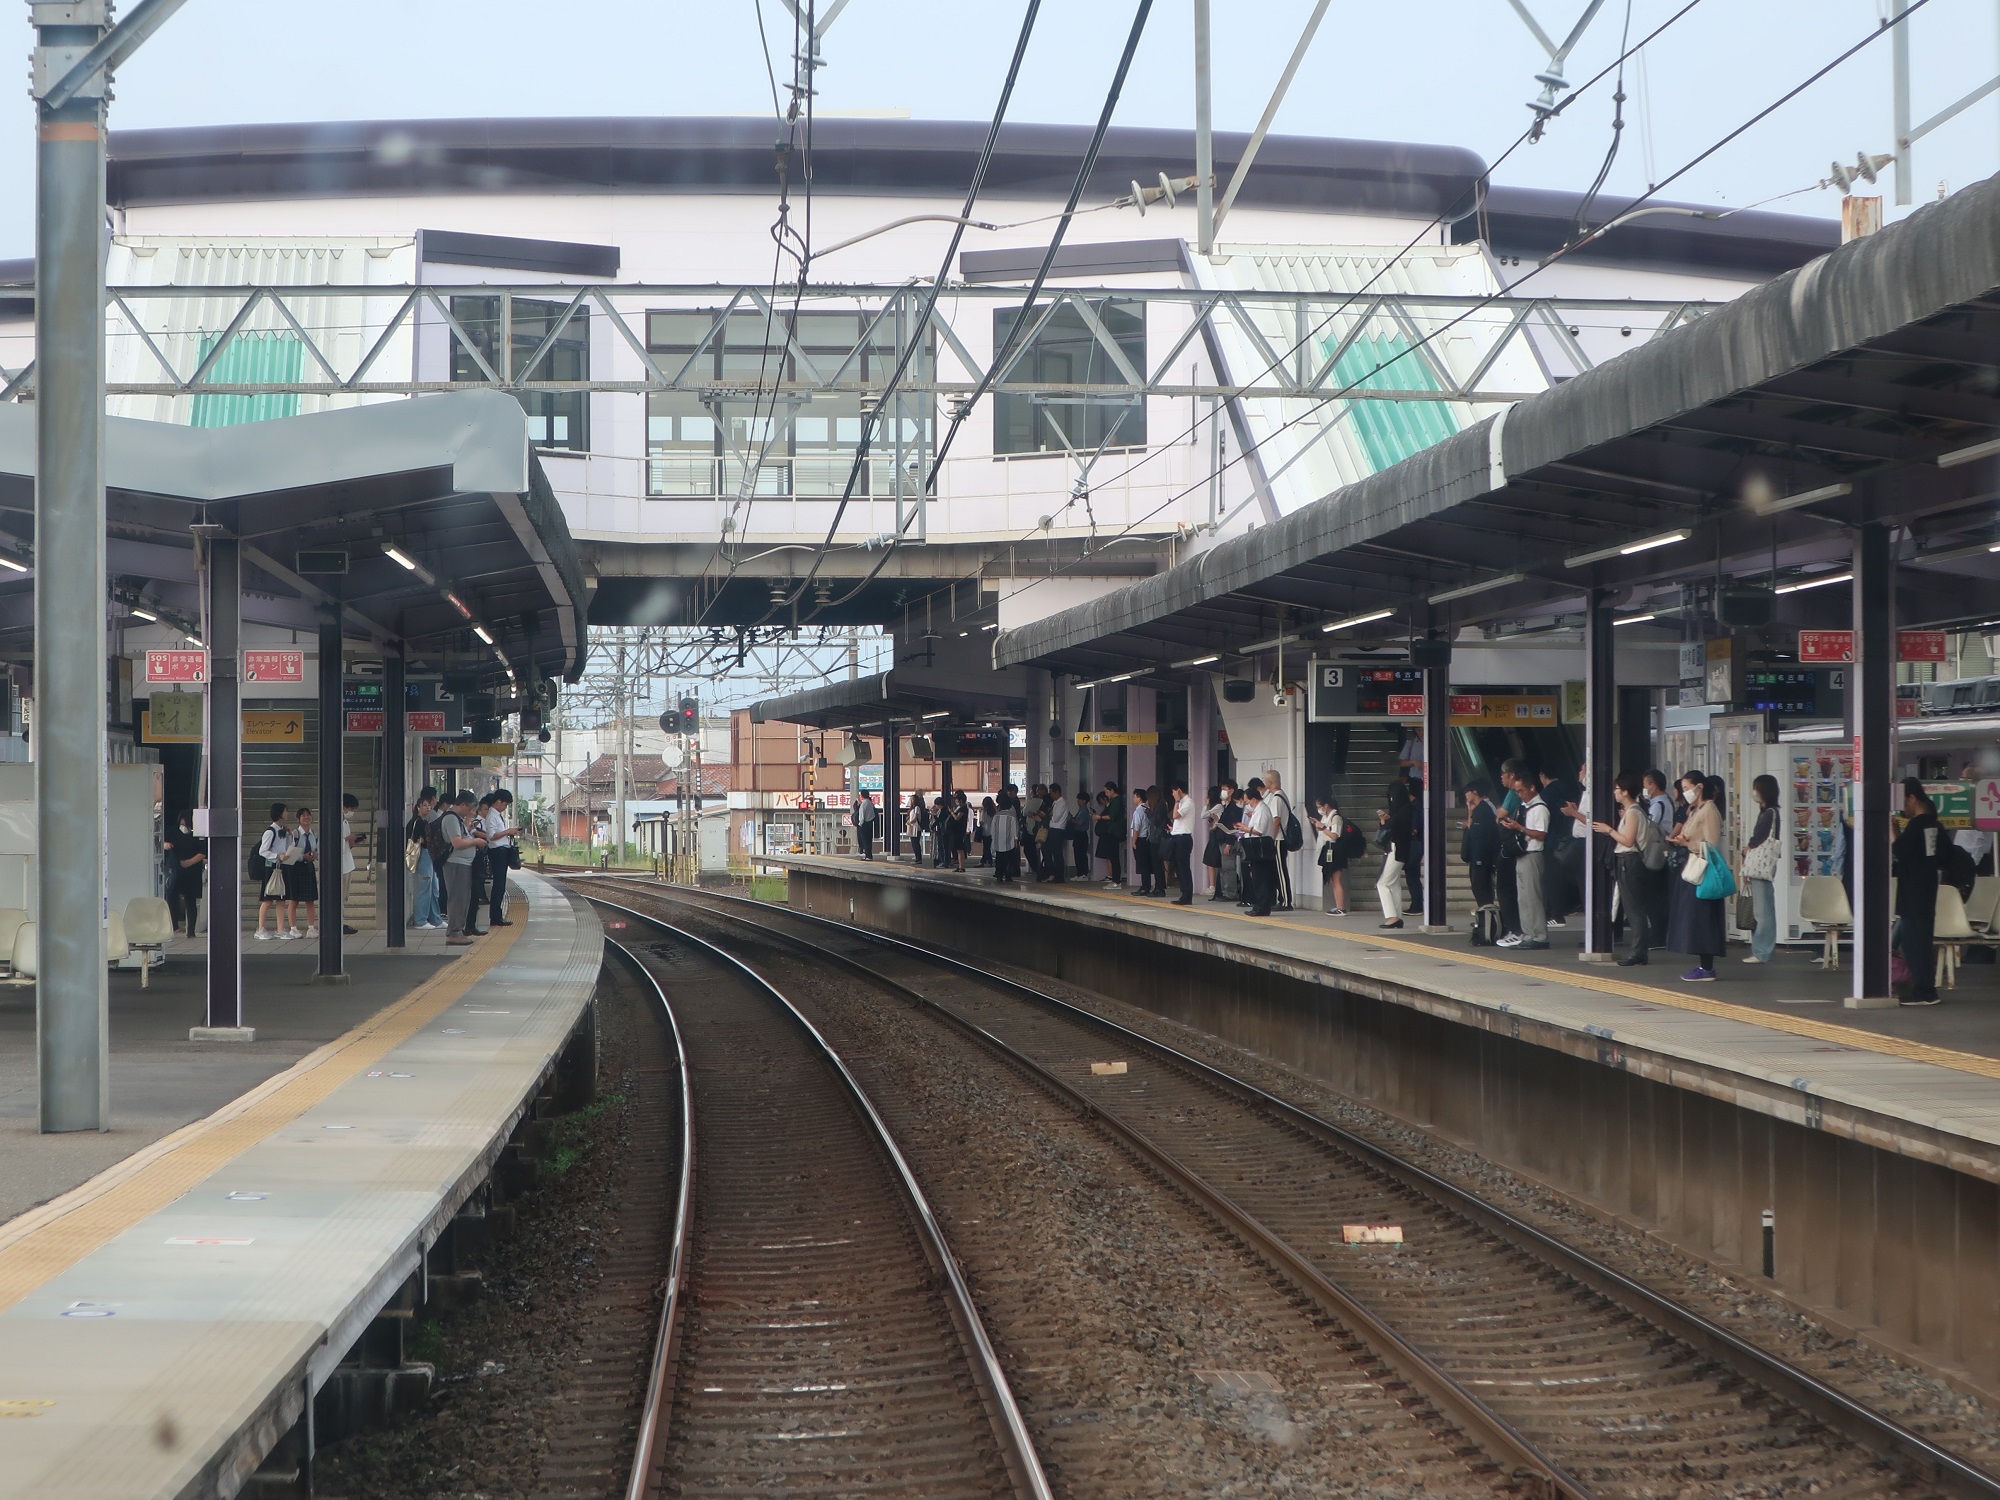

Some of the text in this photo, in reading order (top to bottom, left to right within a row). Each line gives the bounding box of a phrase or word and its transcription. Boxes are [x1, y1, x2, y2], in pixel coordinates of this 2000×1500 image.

[171, 655, 203, 663] 非常通報
[247, 655, 279, 663] 非常通報
[1328, 669, 1339, 685] 3
[1833, 672, 1844, 688] 4
